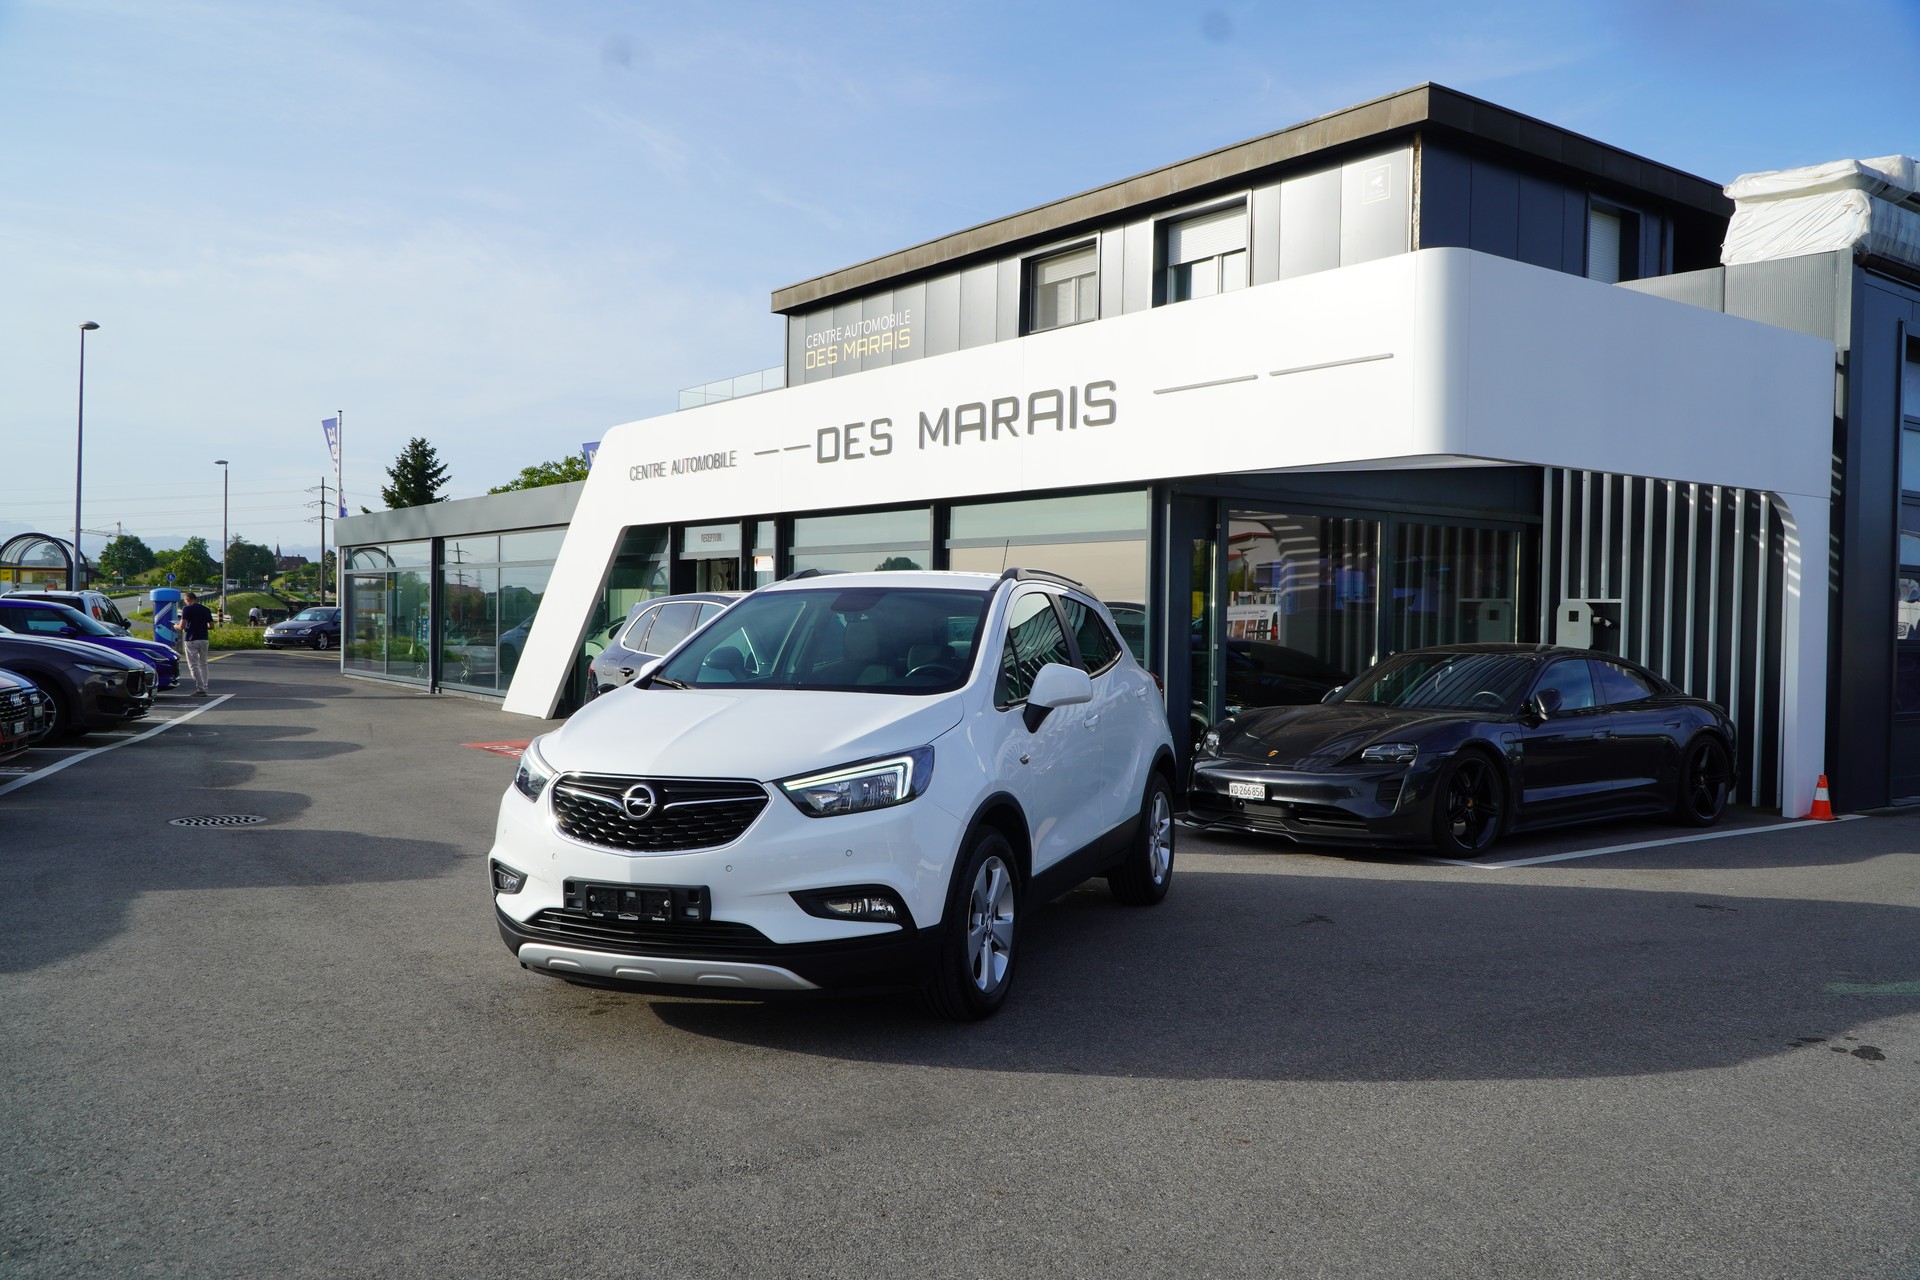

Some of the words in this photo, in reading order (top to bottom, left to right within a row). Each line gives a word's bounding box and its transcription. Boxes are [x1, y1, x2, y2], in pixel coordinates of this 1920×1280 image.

[806, 327, 842, 349] CENTRE
[844, 309, 911, 339] AUTOMOBILE
[806, 345, 838, 369] DES
[843, 328, 910, 360] MARAIS
[629, 461, 667, 481] CENTRE
[670, 450, 737, 475] AUTOMOBILE
[817, 417, 892, 464] DES
[919, 380, 1116, 450] MARAIS
